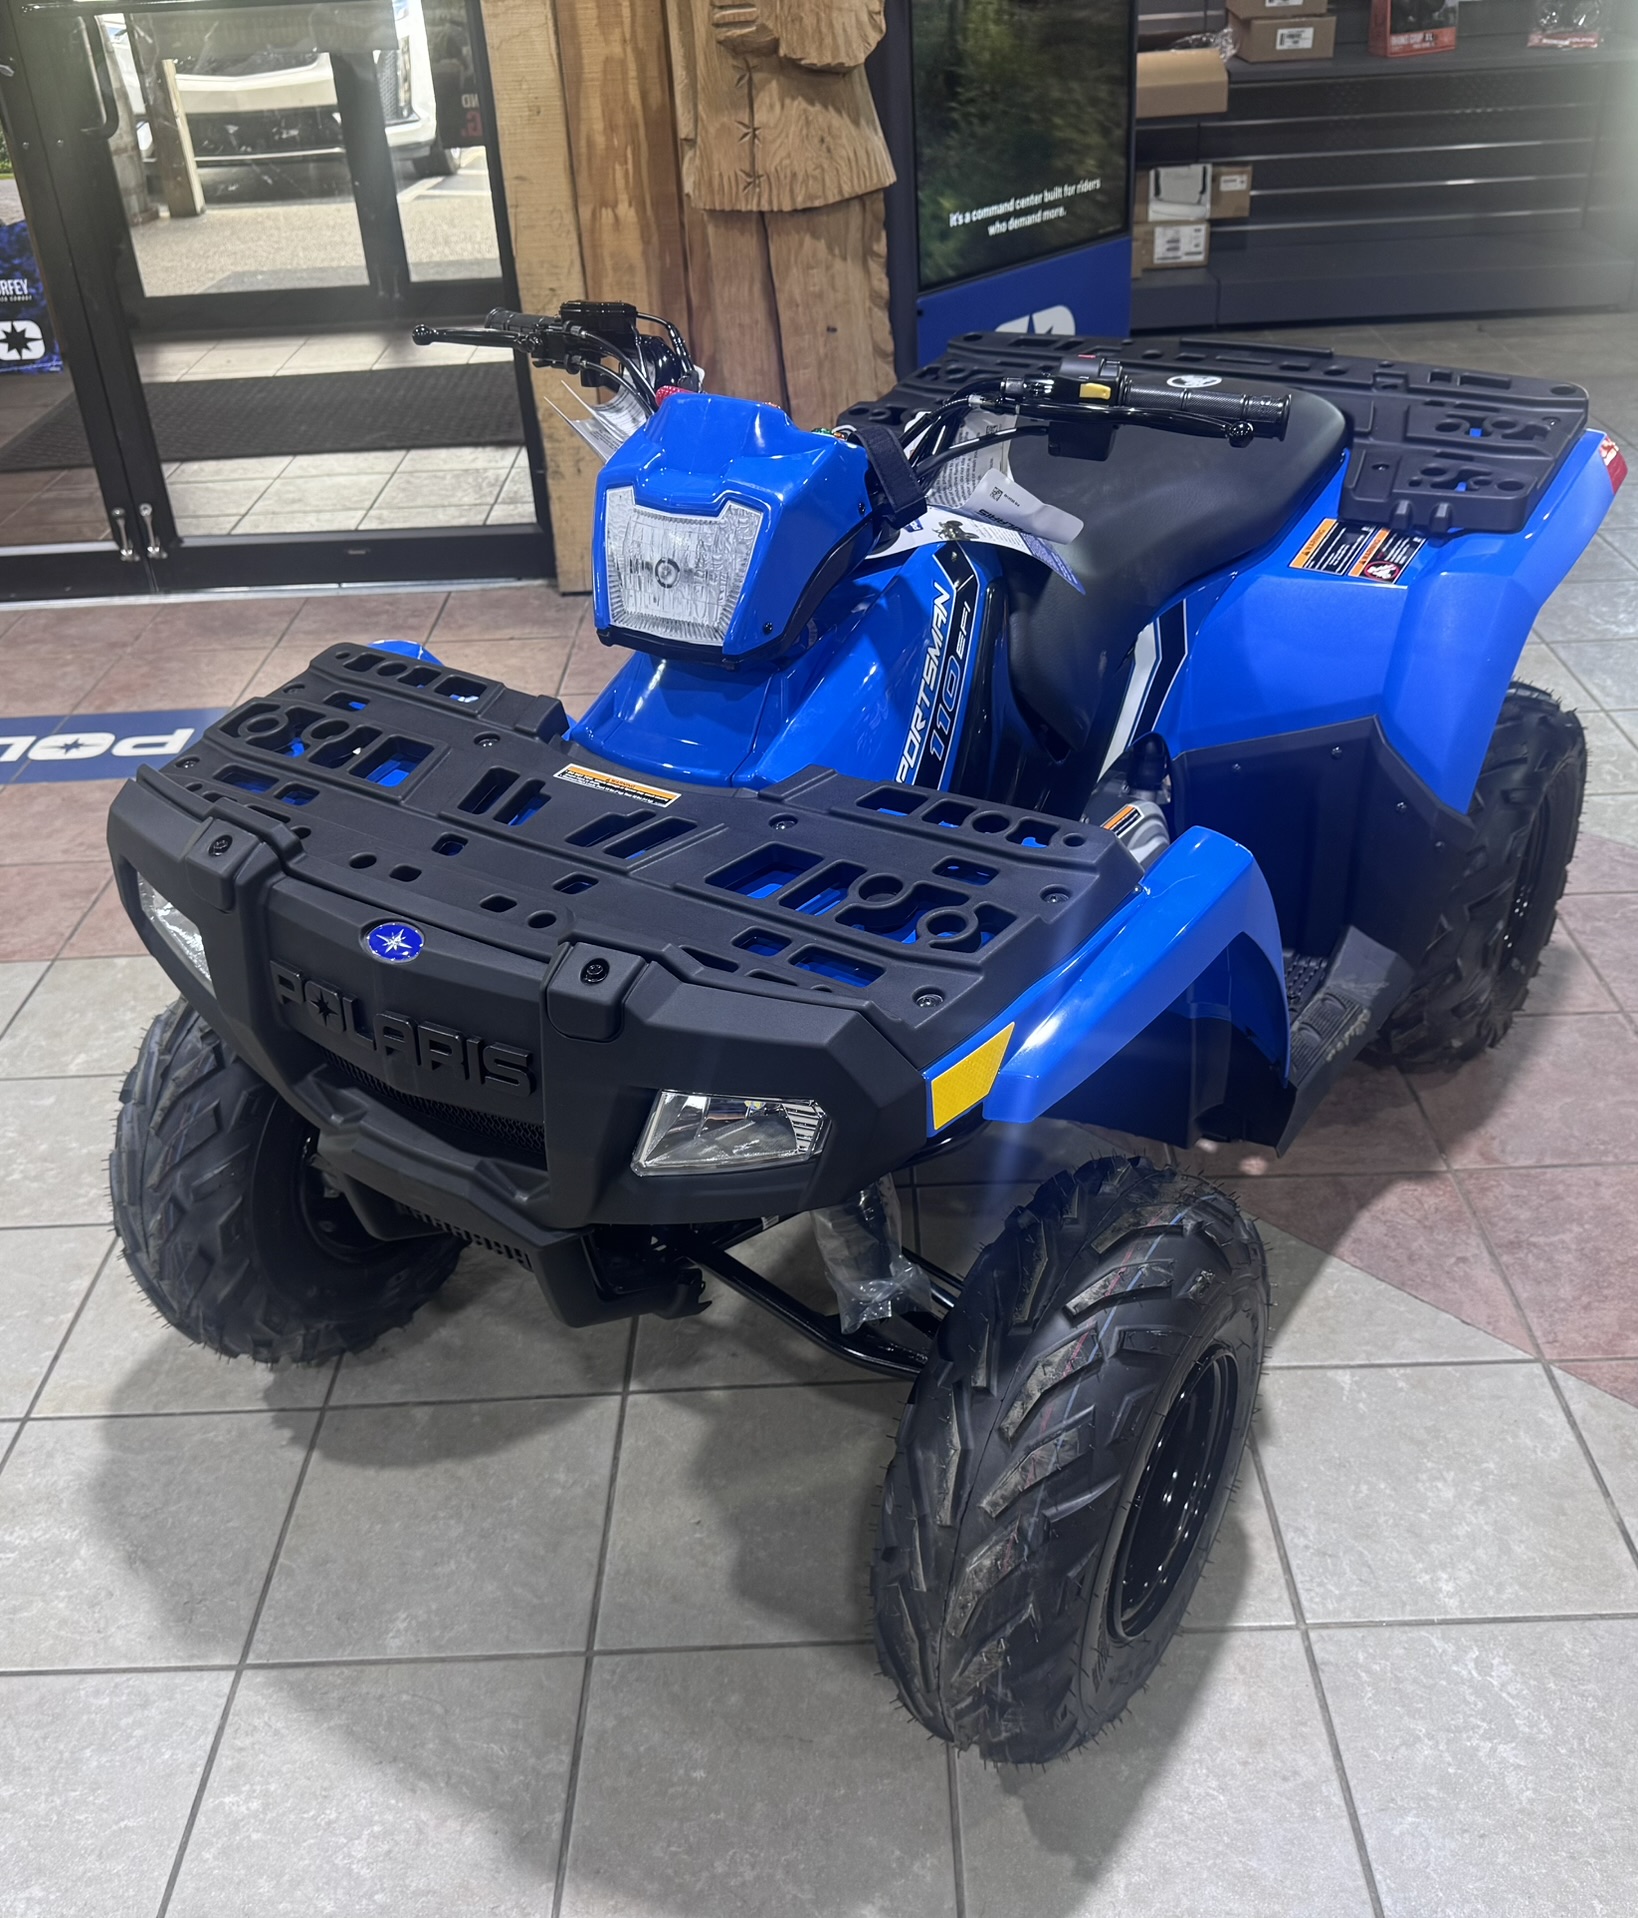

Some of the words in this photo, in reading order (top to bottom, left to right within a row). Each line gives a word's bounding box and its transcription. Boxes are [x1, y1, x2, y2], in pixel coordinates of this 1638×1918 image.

[965, 213, 971, 224] a
[972, 197, 1015, 222] command
[1015, 193, 1043, 211] center
[1044, 186, 1063, 203] built
[1063, 183, 1076, 198] for
[1076, 178, 1101, 194] riders
[987, 220, 1008, 237] who
[1008, 209, 1042, 231] demand
[1042, 205, 1067, 222] more.
[0, 278, 28, 296] RFEY
[975, 508, 1031, 535] OLARIS
[895, 582, 951, 784] PORTSMAN
[929, 655, 961, 761] 110
[956, 601, 971, 660] EFI
[270, 960, 537, 1097] POLARIS
